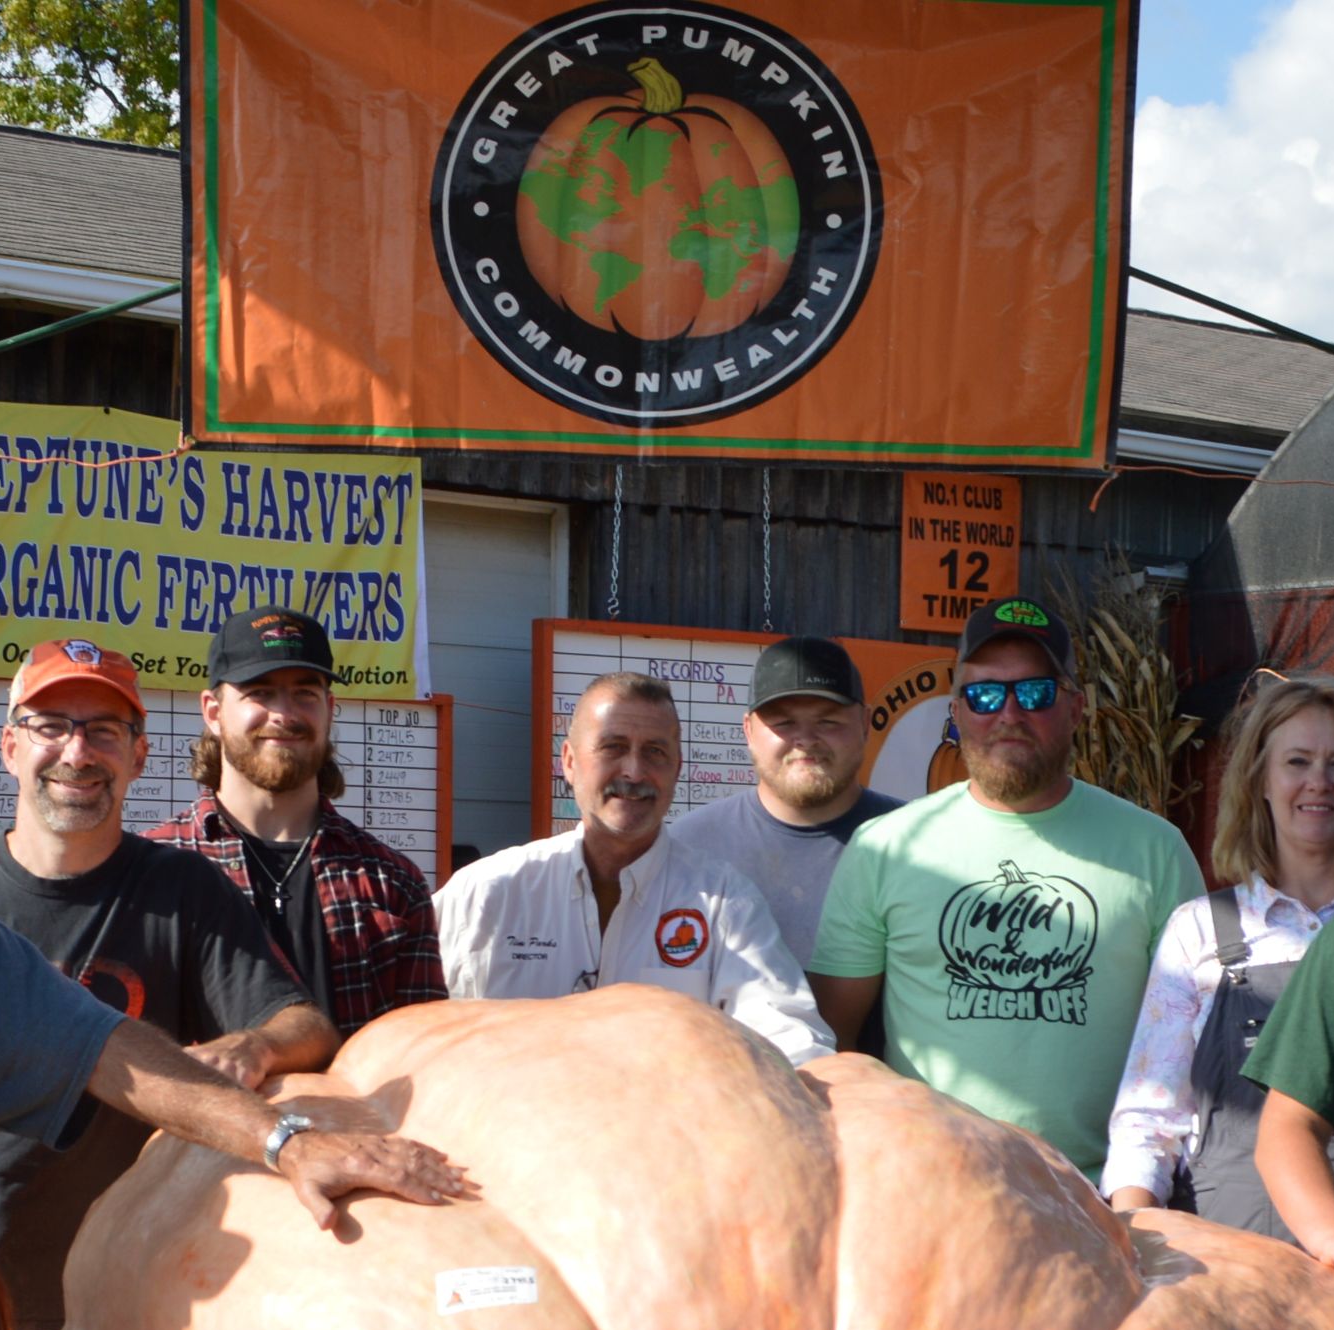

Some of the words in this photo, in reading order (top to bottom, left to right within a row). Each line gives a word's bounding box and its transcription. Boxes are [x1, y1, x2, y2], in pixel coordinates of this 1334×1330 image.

[472, 33, 600, 164] GREAT
[642, 25, 847, 179] PUMPKIN
[475, 257, 839, 393] COMMONWEALTH
[220, 462, 413, 546] HARVEST
[963, 485, 1003, 510] CLUB
[909, 517, 925, 541] IN
[930, 519, 961, 543] THE
[965, 521, 1014, 547] WORLD
[939, 549, 989, 592] 12
[131, 653, 167, 673] Set
[336, 665, 408, 686] Motion
[648, 659, 725, 683] RECORDS
[716, 684, 736, 704] PA
[871, 671, 937, 731] OHIO
[379, 708, 399, 725] TOP
[367, 748, 373, 762] 2
[366, 770, 372, 784] 3
[366, 790, 372, 804] 4
[366, 811, 372, 825] 5
[970, 884, 1064, 933] Wild
[1000, 927, 1022, 957] &
[955, 943, 1085, 979] Wonderful
[947, 982, 1037, 1020] WEIGH
[1040, 984, 1088, 1025] OFF
